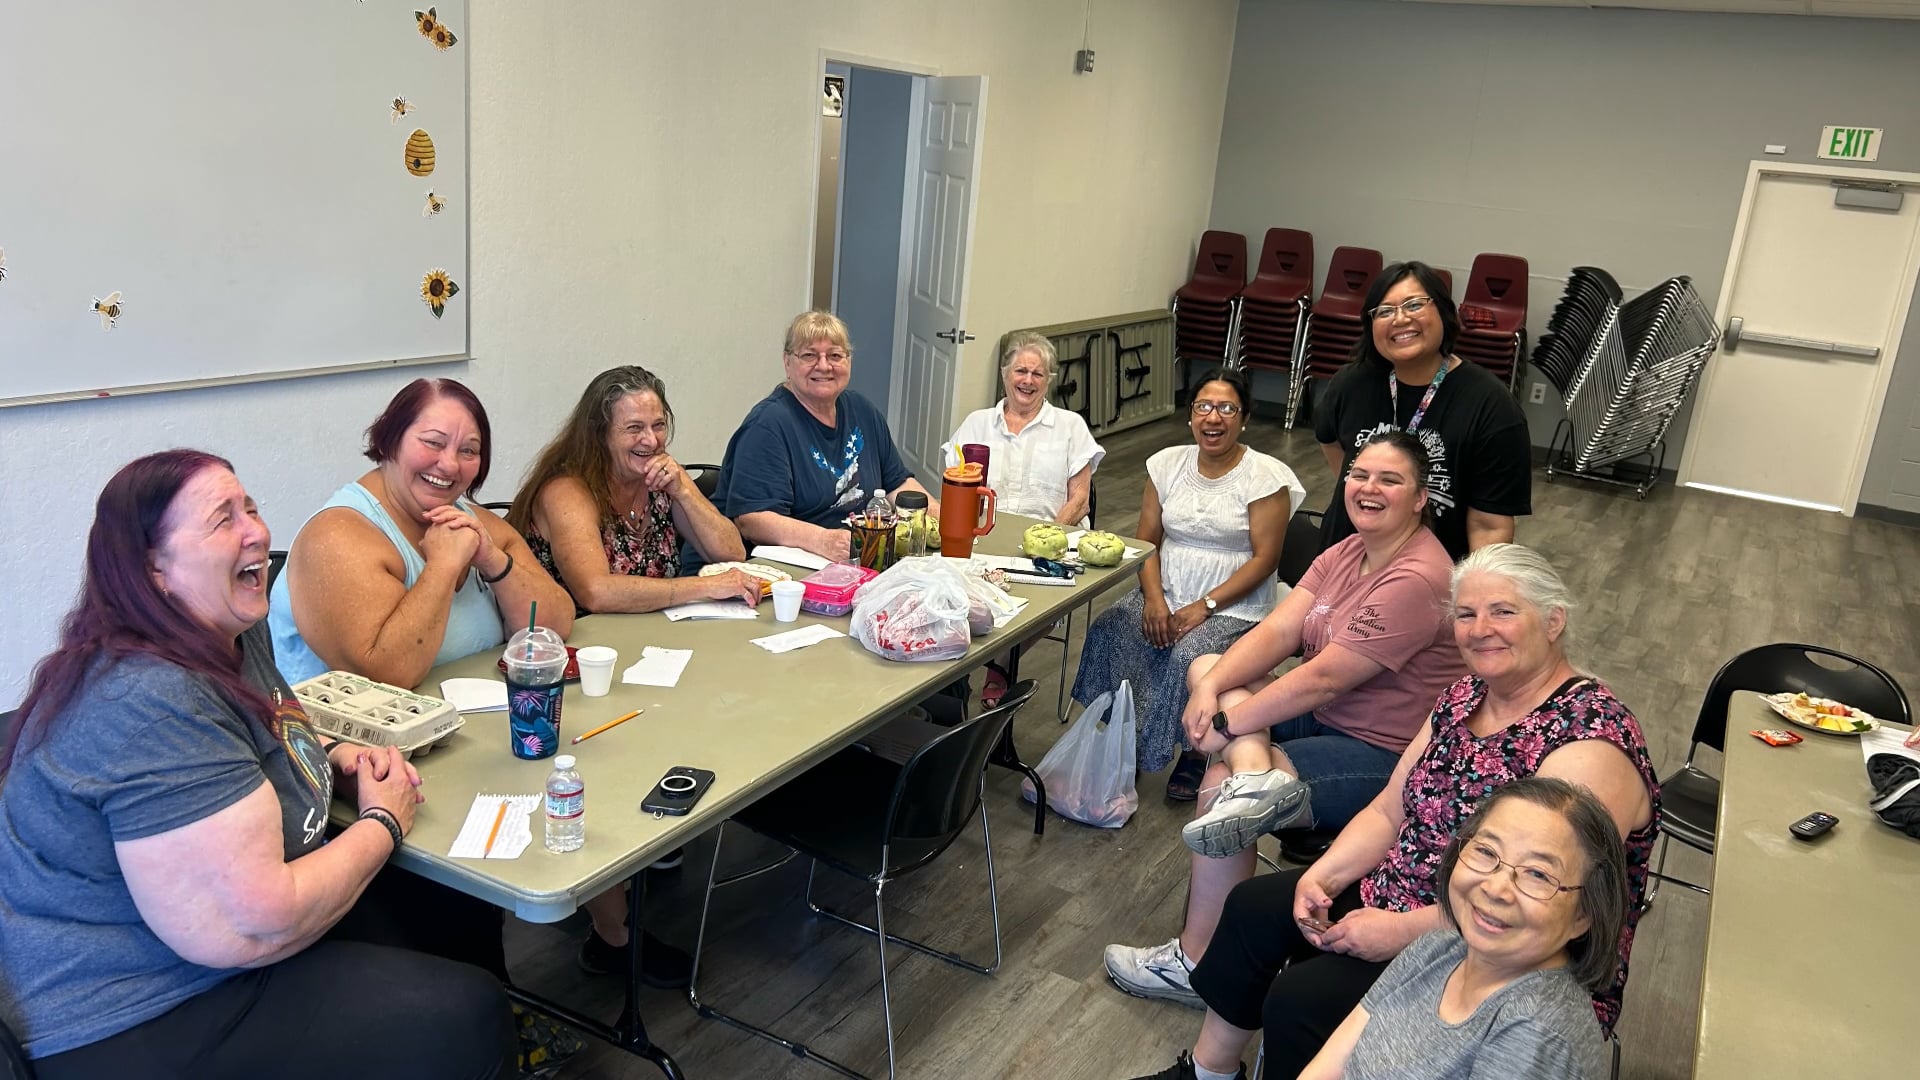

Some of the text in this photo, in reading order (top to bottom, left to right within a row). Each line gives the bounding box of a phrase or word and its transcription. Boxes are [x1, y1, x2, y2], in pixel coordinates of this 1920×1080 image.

[1829, 128, 1874, 157] EXIT
[1363, 607, 1380, 618] The
[1347, 622, 1371, 639] Army
[902, 637, 937, 652] You
